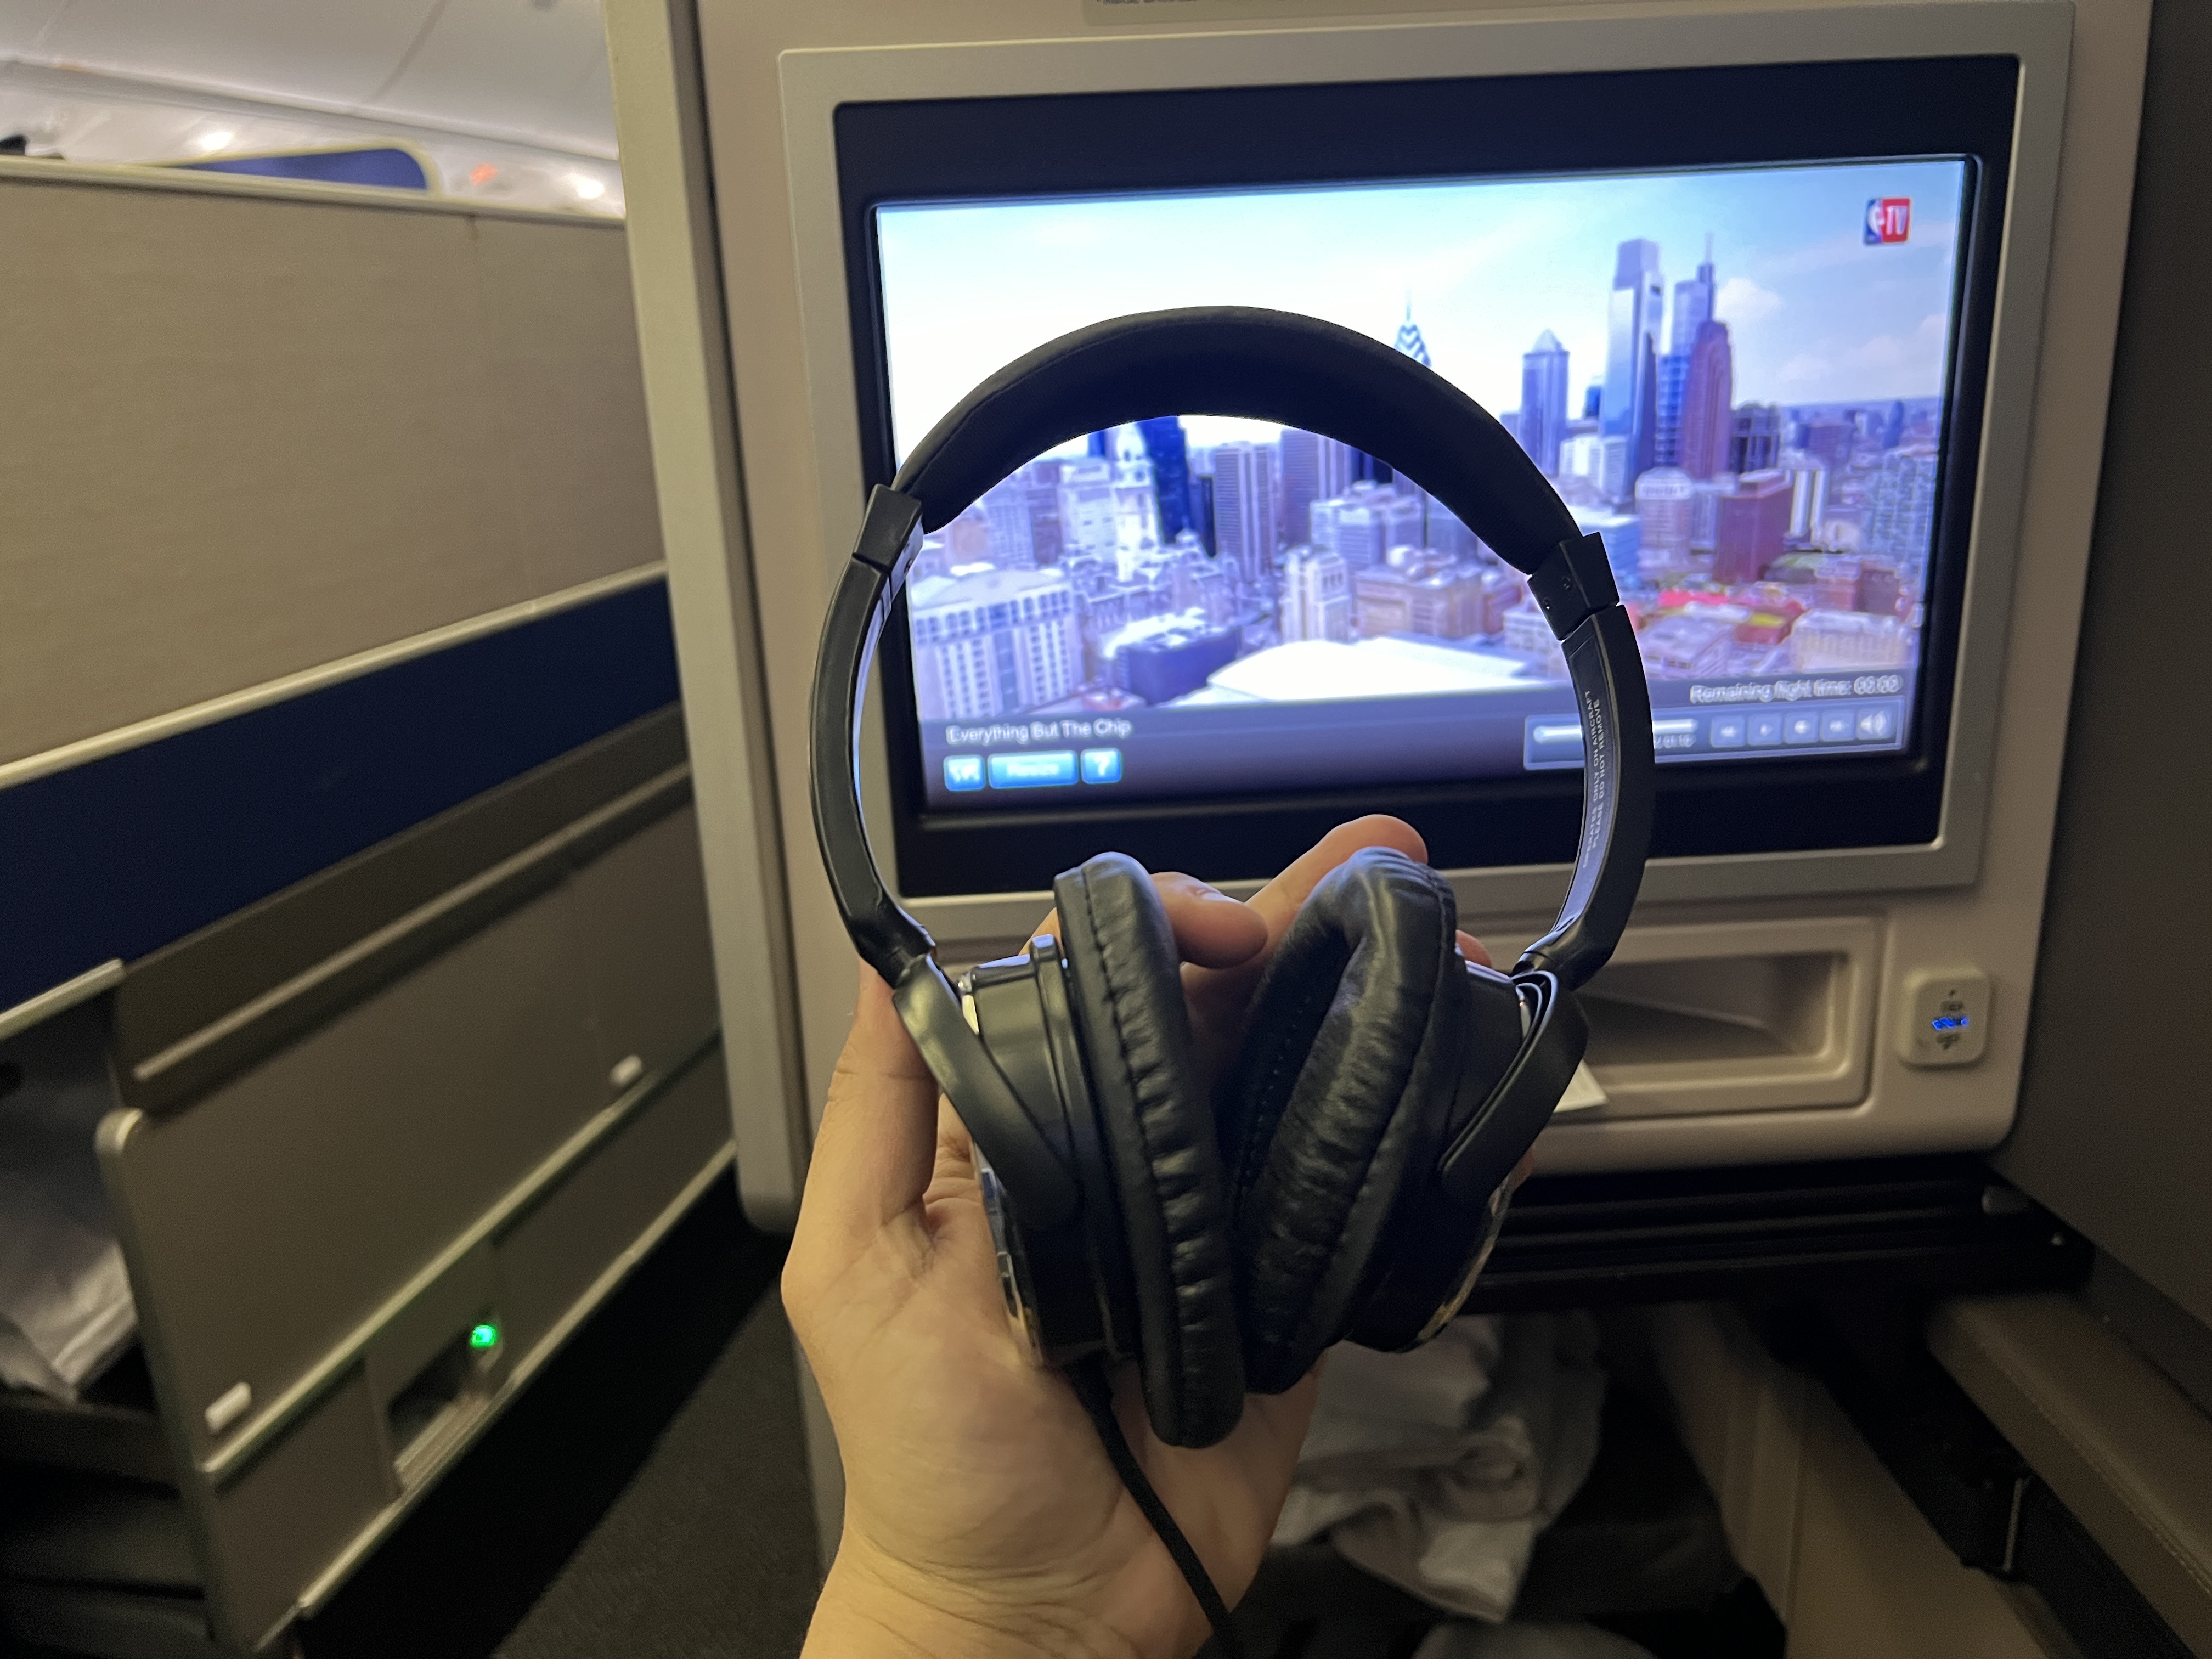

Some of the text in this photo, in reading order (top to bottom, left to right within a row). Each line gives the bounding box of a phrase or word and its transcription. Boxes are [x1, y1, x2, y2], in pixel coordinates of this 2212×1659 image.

[1690, 682, 1774, 703] Remaining
[1774, 680, 1812, 701] flight
[947, 718, 1132, 746] Everything But The Chip
[1584, 691, 1598, 745] AIRCRAFT
[1593, 699, 1604, 750] REMOVE
[1593, 749, 1599, 767] ON
[1599, 781, 1605, 799] DO
[1592, 802, 1603, 848] PLEASE
